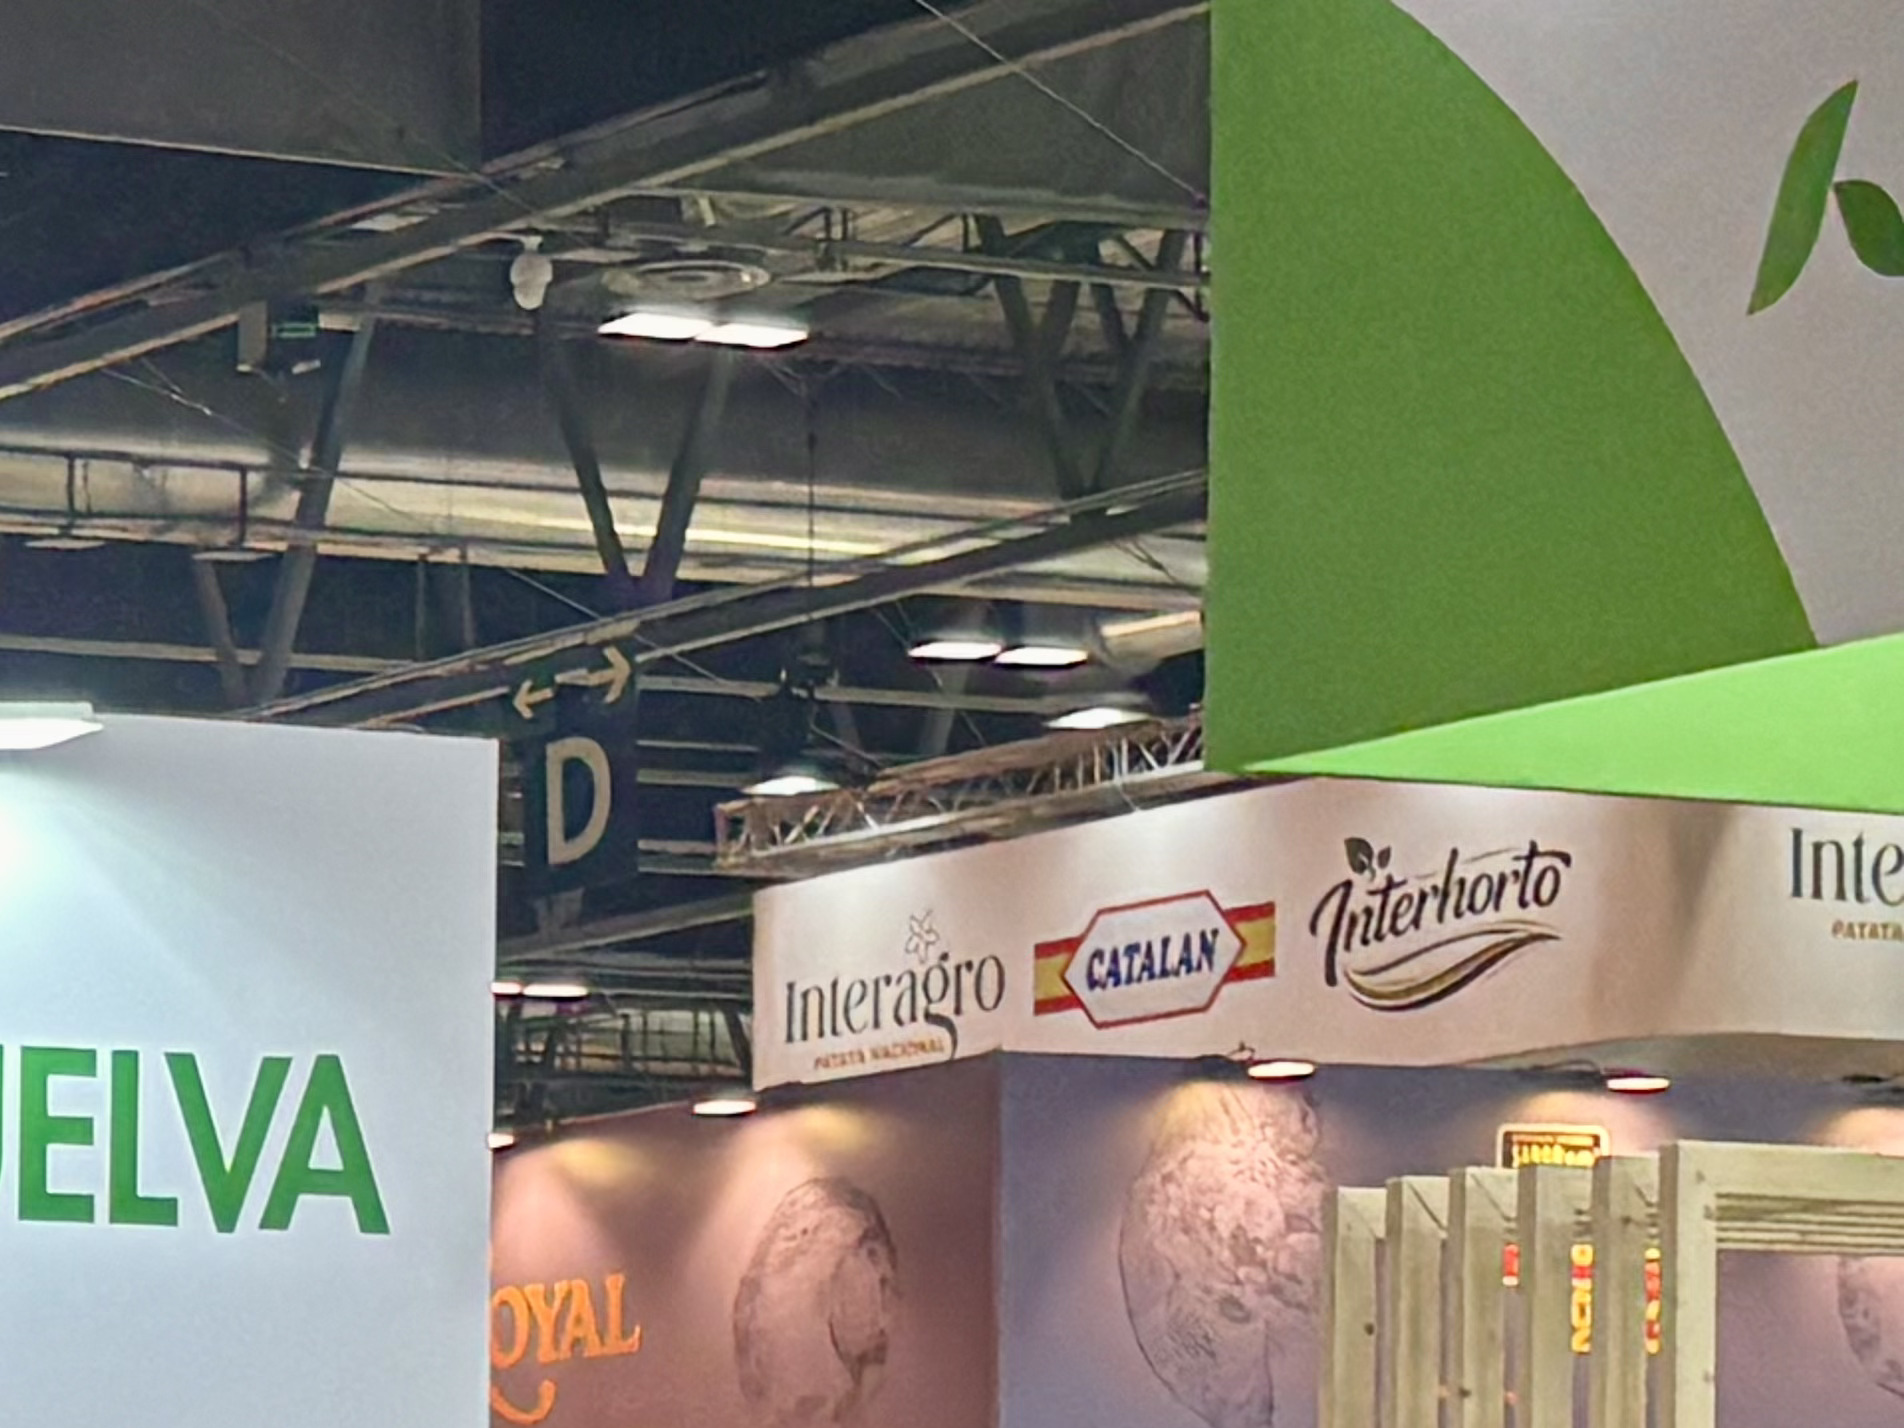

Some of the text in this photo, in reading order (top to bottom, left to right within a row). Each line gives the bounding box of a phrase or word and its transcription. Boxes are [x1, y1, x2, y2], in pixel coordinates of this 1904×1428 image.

[545, 736, 611, 865] D
[1086, 928, 1220, 991] CATALAN
[1309, 839, 1572, 987] Interhorto
[785, 951, 1006, 1061] Interagro
